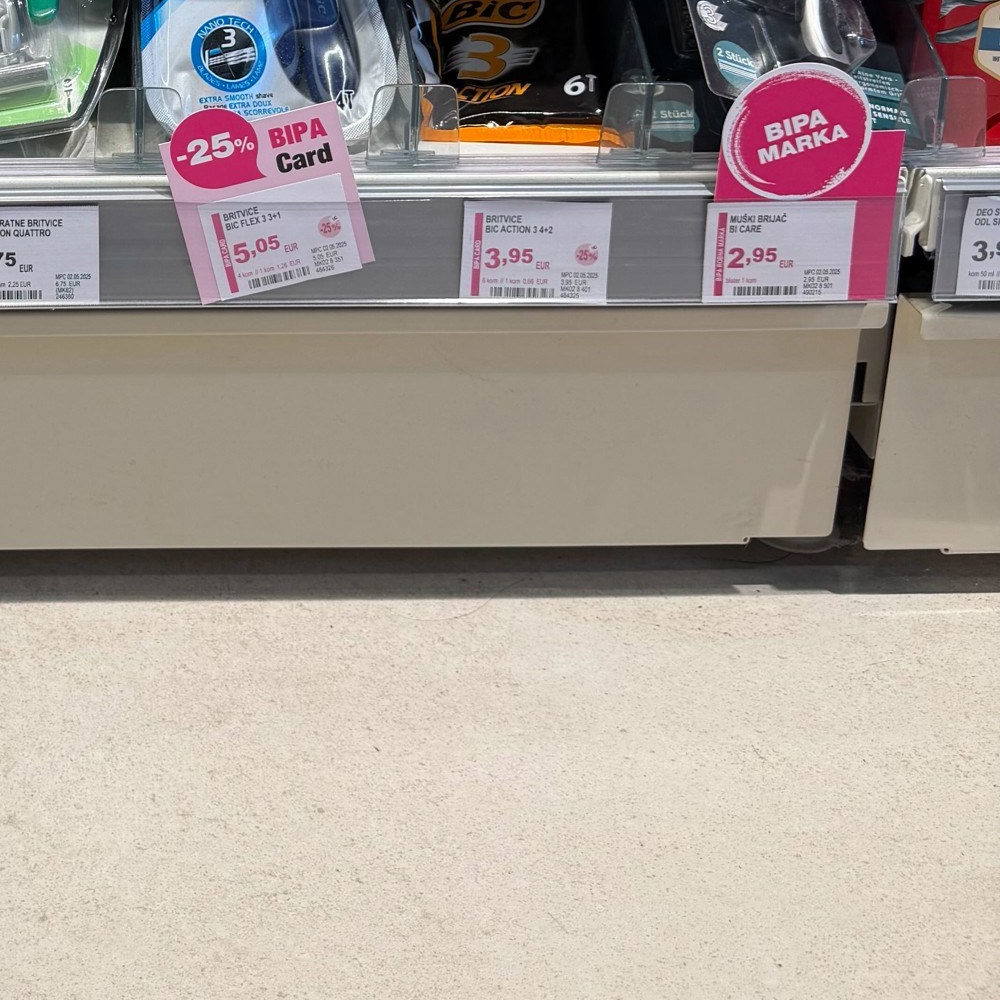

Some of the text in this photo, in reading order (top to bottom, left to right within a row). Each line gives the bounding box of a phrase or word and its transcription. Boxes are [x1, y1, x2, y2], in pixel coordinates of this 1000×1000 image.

[199, 95, 222, 104] EXTRA
[225, 93, 254, 101] SMOOTH
[268, 117, 328, 149] BIPA
[764, 108, 829, 143] BIPA
[176, 131, 255, 166] -25%
[757, 123, 849, 165] MARKA
[276, 142, 333, 173] Card
[27, 219, 63, 227] BRITVICE
[223, 206, 259, 222] BRITVICE
[225, 212, 281, 231] BIC FLEX 3 3+1
[13, 229, 51, 237] QUATTRO
[485, 225, 499, 233] BIC
[500, 225, 531, 233] ACTION
[539, 226, 553, 234] 4+2
[233, 234, 280, 264] 5,05
[484, 248, 533, 269] 3,95
[727, 247, 777, 269] 2,95
